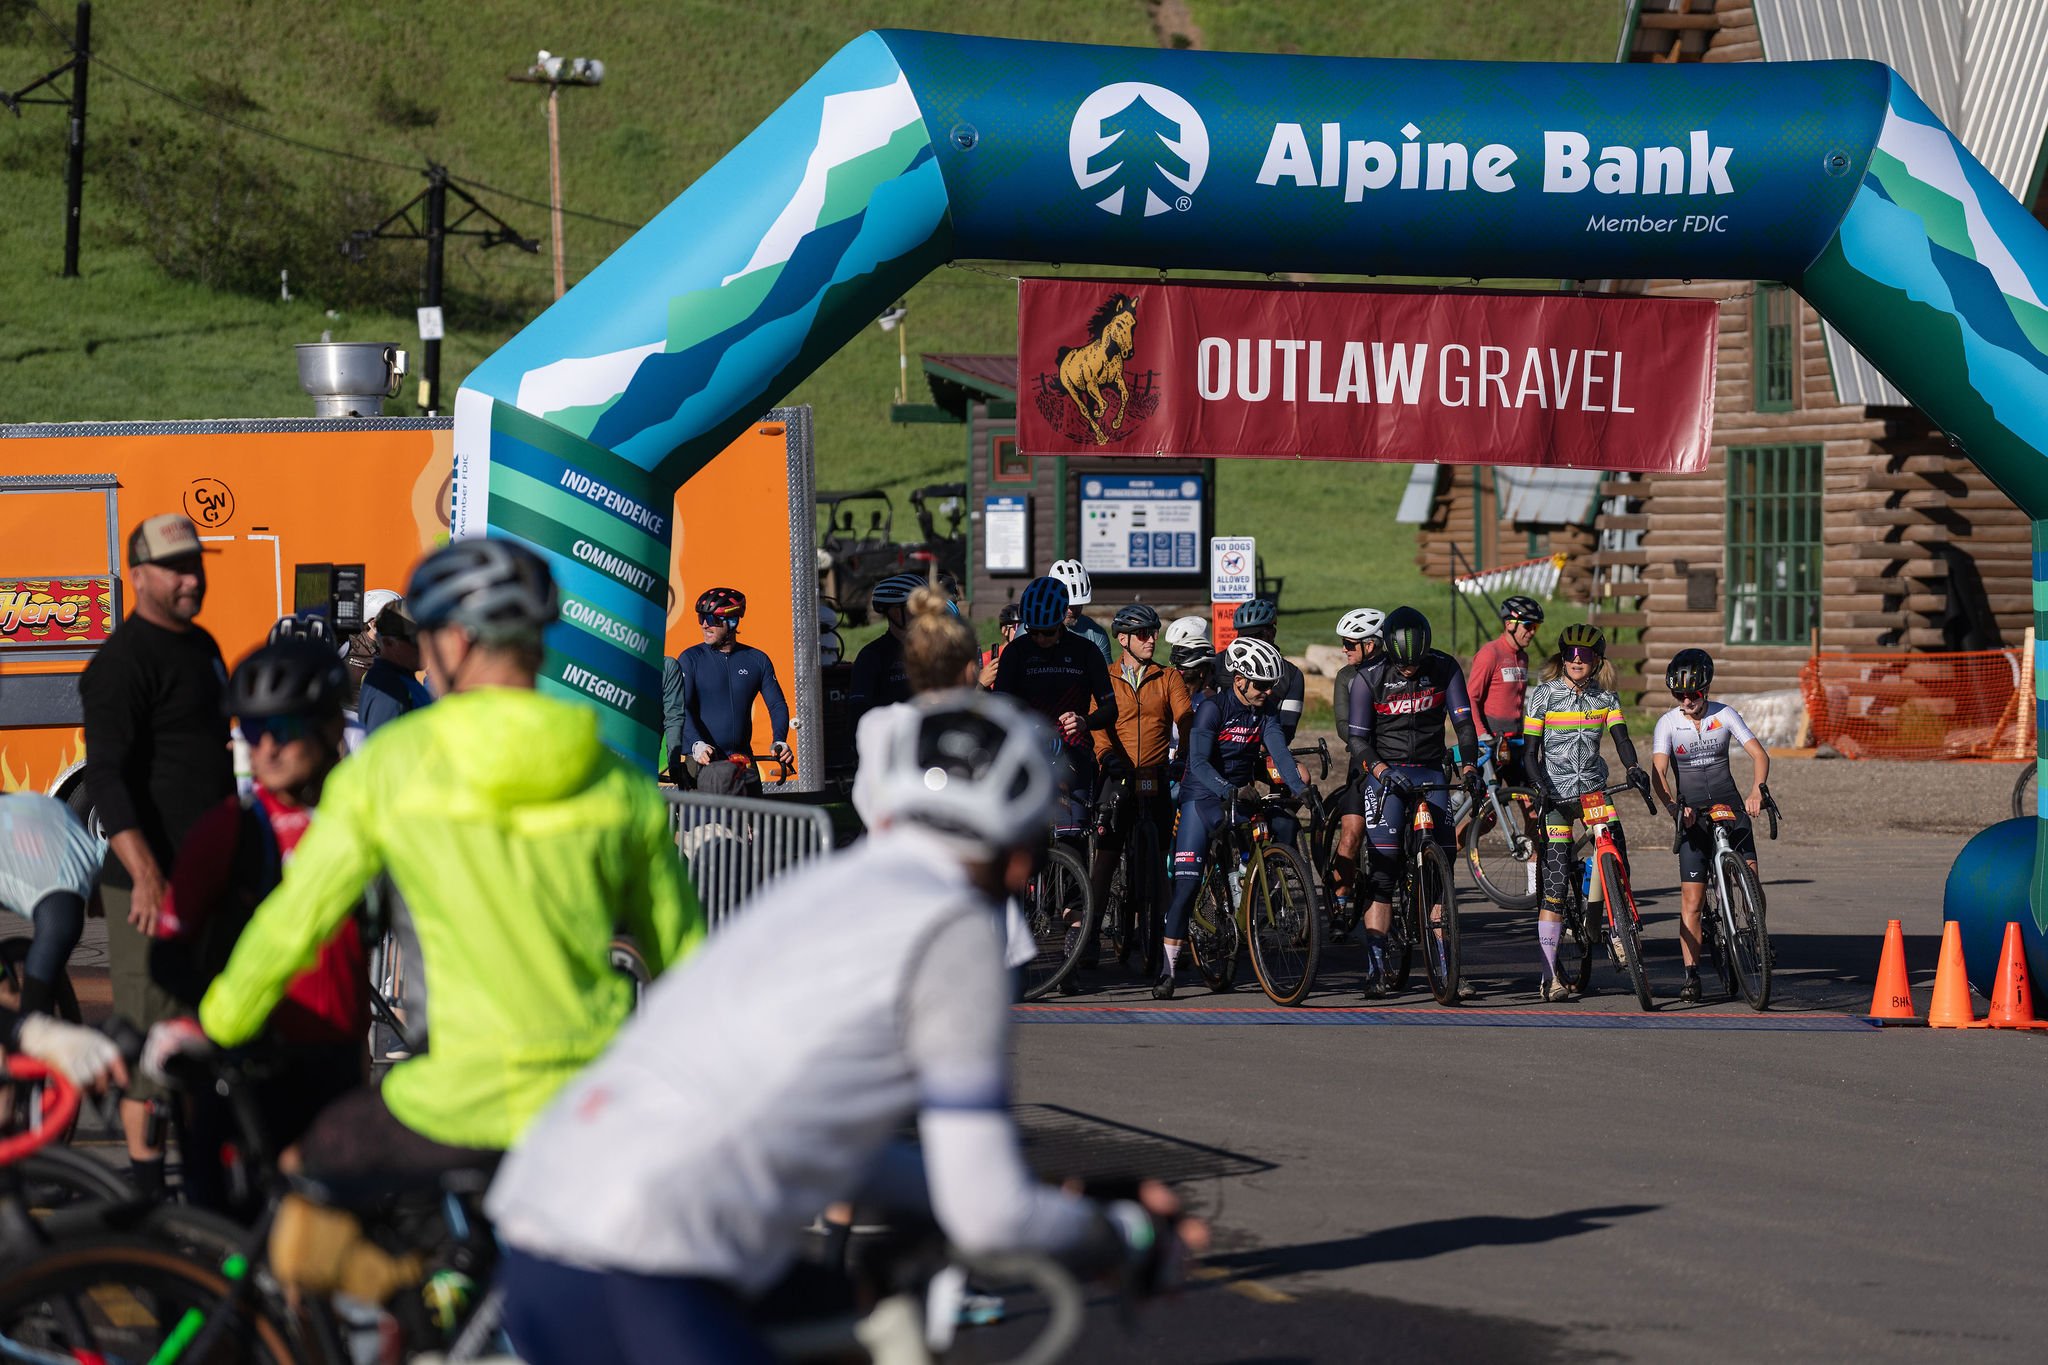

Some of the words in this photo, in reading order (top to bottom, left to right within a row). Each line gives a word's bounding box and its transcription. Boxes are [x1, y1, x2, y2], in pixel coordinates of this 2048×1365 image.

[1256, 122, 1518, 203] Alpine
[1542, 130, 1734, 197] Bank
[1586, 215, 1677, 234] Member
[1682, 215, 1729, 234] FDIC
[1196, 336, 1428, 405] OUTLAW
[1438, 343, 1635, 414] GRAVEL
[460, 484, 468, 537] Member
[560, 468, 664, 535] INDEPENDENCE
[572, 539, 656, 593] COMMUNITY
[1215, 543, 1226, 551] NO
[1229, 543, 1251, 551] DOGS
[1217, 575, 1250, 583] ALLOWED
[1229, 584, 1247, 592] PARK
[0, 592, 78, 632] Here
[562, 599, 650, 654] COMPASSION
[562, 663, 636, 711] INTEGRITY
[1141, 779, 1152, 790] 68
[1416, 812, 1431, 822] 136
[1589, 806, 1604, 818] 137
